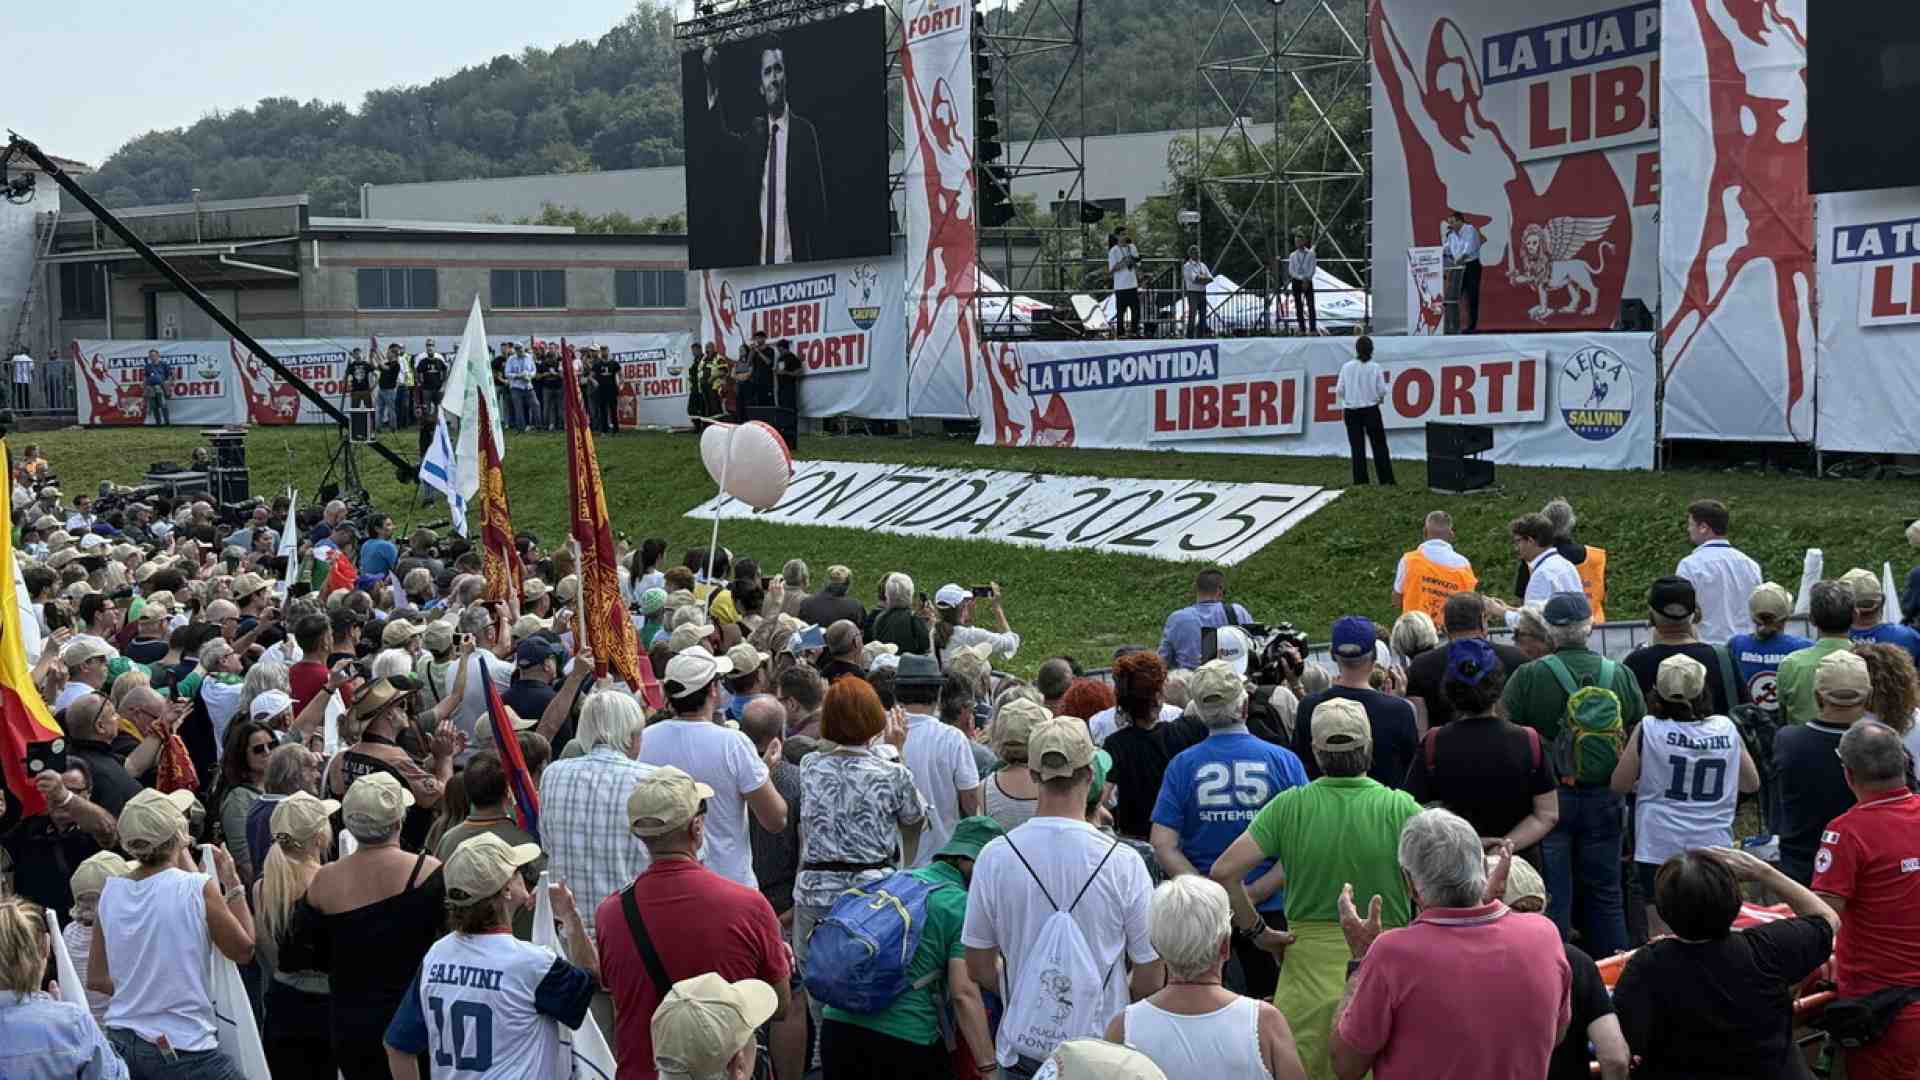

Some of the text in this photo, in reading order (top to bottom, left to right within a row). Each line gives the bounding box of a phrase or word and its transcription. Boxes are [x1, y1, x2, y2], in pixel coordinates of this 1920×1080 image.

[909, 6, 961, 38] FORTI
[1488, 35, 1537, 78] LA
[1544, 16, 1625, 66] TUA
[1836, 228, 1885, 259] LA
[742, 276, 835, 310] LA TUA PONTIDA
[752, 303, 820, 338] LIBERI
[797, 333, 865, 369] FORTI
[1564, 350, 1624, 382] LEGA
[624, 362, 657, 378] IBERI
[644, 378, 683, 396] FORTI
[1030, 349, 1214, 391] LA TUA PONTIDA
[1154, 378, 1296, 432] LIBERI
[1313, 358, 1537, 422] E ORTI
[1568, 410, 1624, 426] SALVINI
[711, 471, 1296, 551] ONTIDA 2025
[1667, 732, 1732, 750] SALVINI
[1195, 760, 1268, 807] 25
[1664, 755, 1728, 801] 10
[428, 963, 504, 991] SALVINI
[428, 996, 493, 1072] 10
